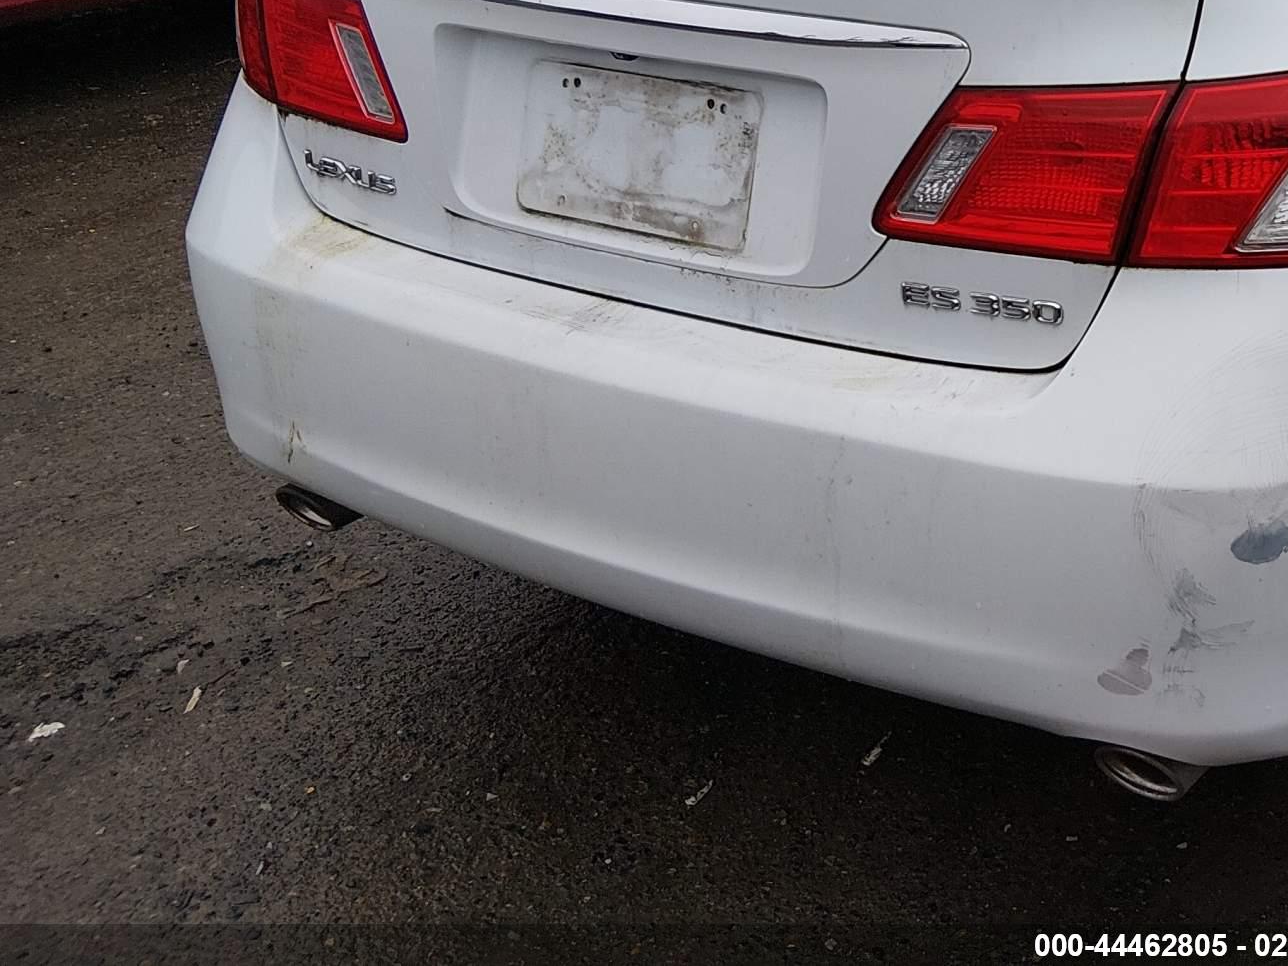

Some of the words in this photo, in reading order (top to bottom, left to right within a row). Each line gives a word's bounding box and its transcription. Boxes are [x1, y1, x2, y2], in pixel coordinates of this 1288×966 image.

[304, 149, 397, 195] LEXUS
[901, 282, 961, 311] ES
[969, 291, 1064, 325] 350
